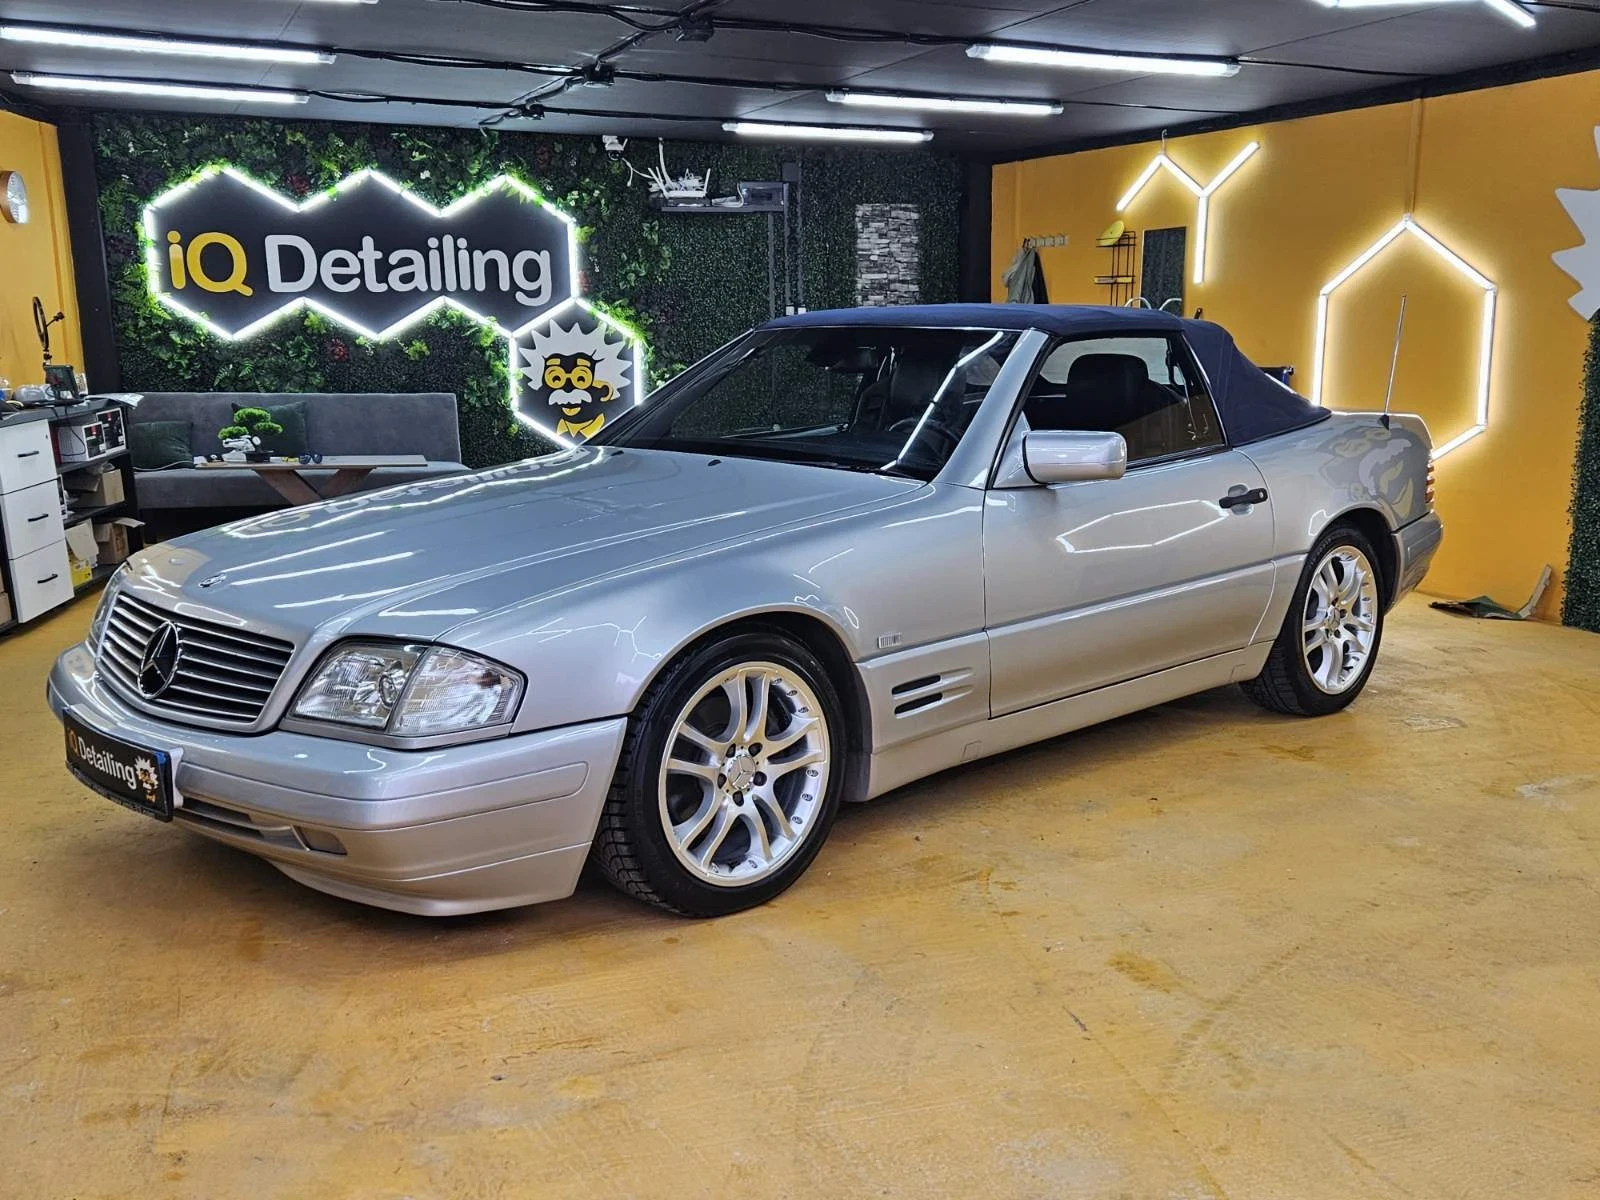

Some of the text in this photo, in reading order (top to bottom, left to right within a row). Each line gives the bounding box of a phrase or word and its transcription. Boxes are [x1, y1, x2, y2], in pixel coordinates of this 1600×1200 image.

[167, 230, 552, 306] iQ Detailing
[78, 736, 137, 790] Detailing
